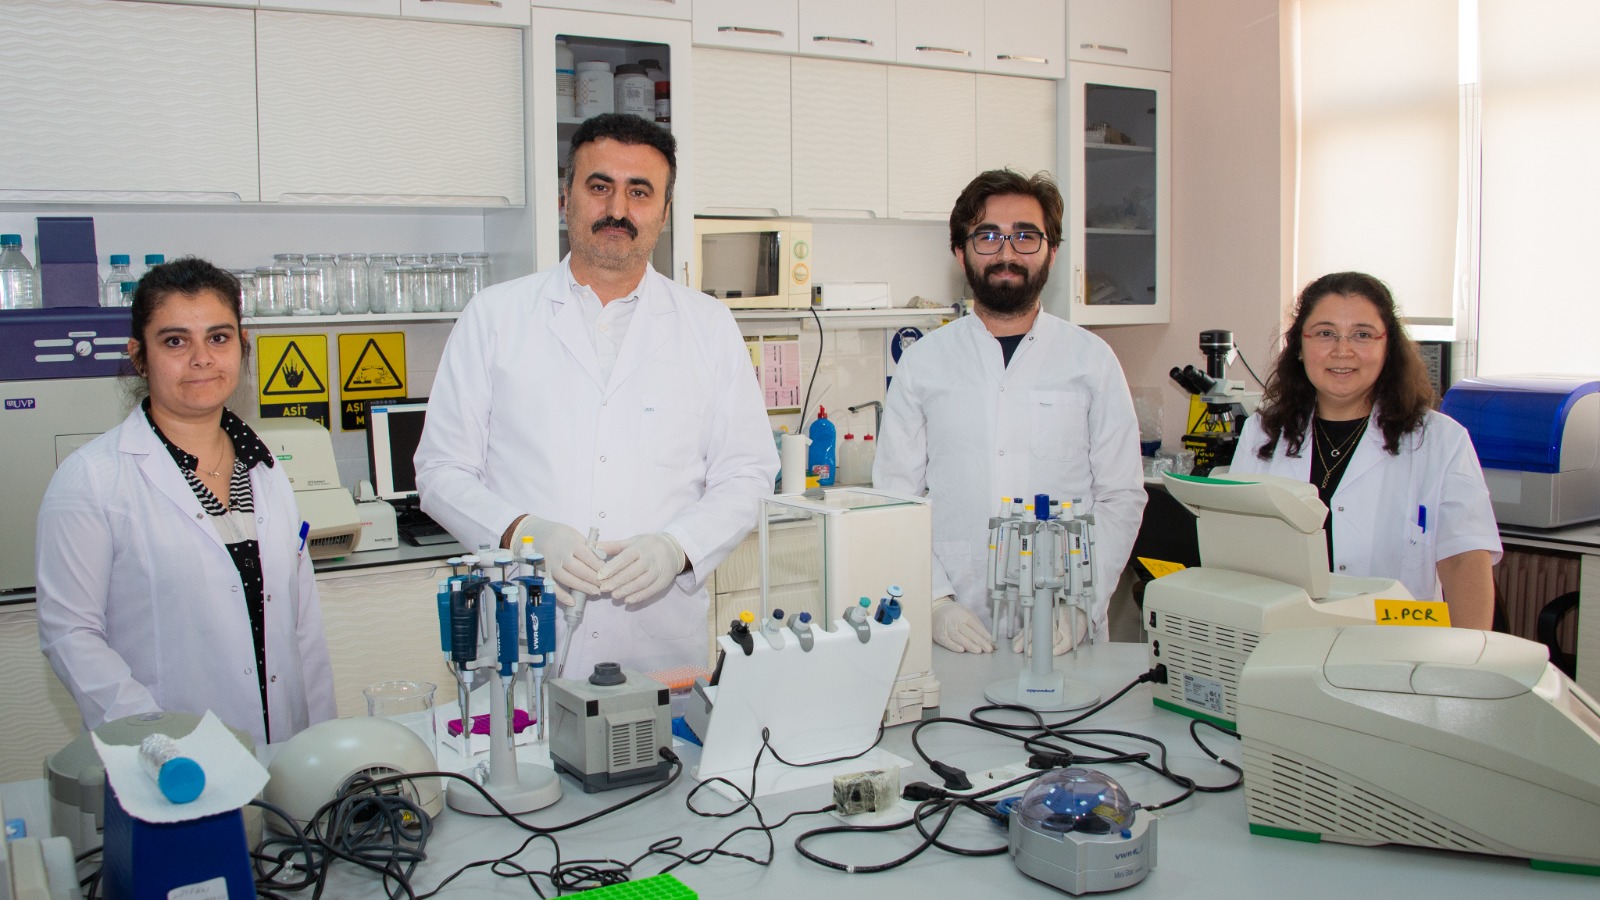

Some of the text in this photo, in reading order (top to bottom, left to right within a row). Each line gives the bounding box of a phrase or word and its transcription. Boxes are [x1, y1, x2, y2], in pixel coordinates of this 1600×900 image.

[13, 399, 34, 408] UVP
[346, 402, 363, 414] AŞI
[282, 404, 308, 416] ASİT
[1115, 850, 1133, 860] VWR
